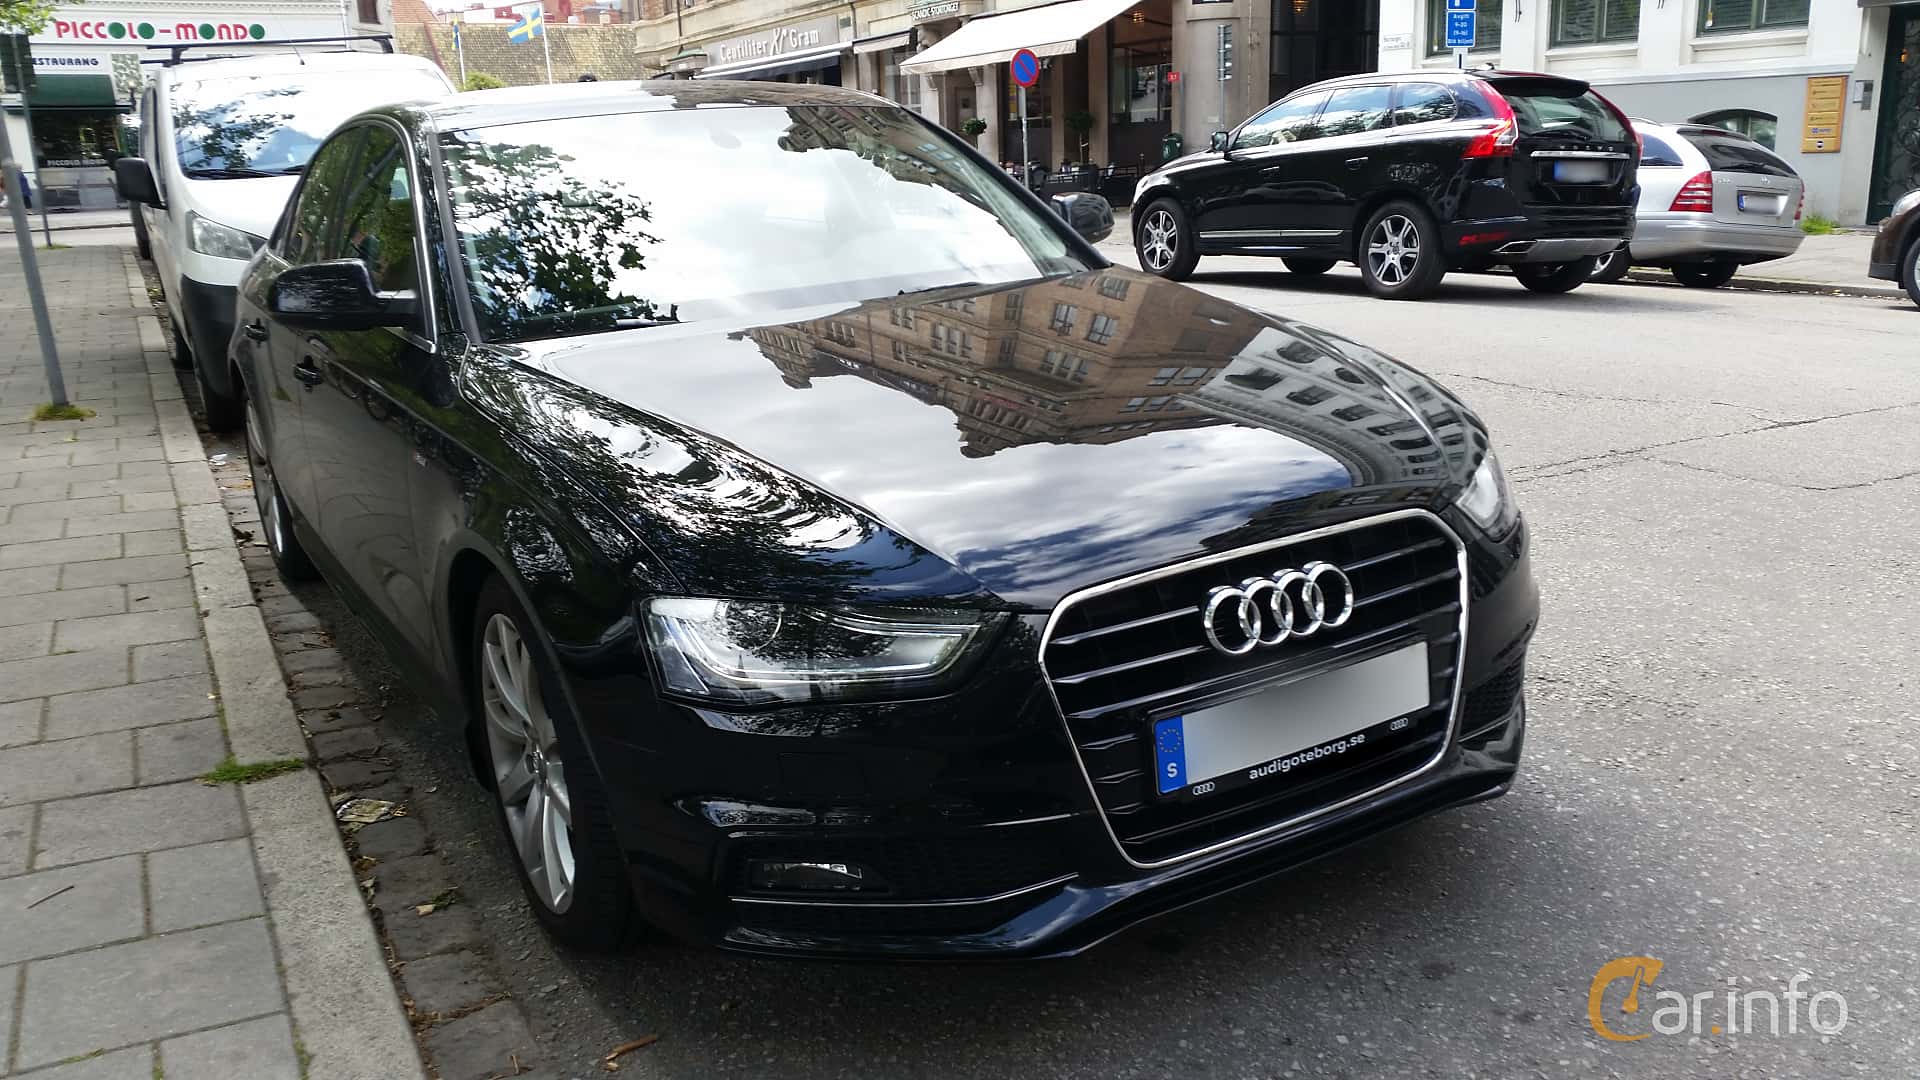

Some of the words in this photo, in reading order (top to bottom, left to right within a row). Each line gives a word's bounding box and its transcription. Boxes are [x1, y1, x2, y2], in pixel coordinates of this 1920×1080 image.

[789, 28, 819, 48] Gram
[31, 57, 99, 66] ESTAURANG
[1249, 733, 1366, 780] audigoteborg.se
[1166, 761, 1178, 779] S
